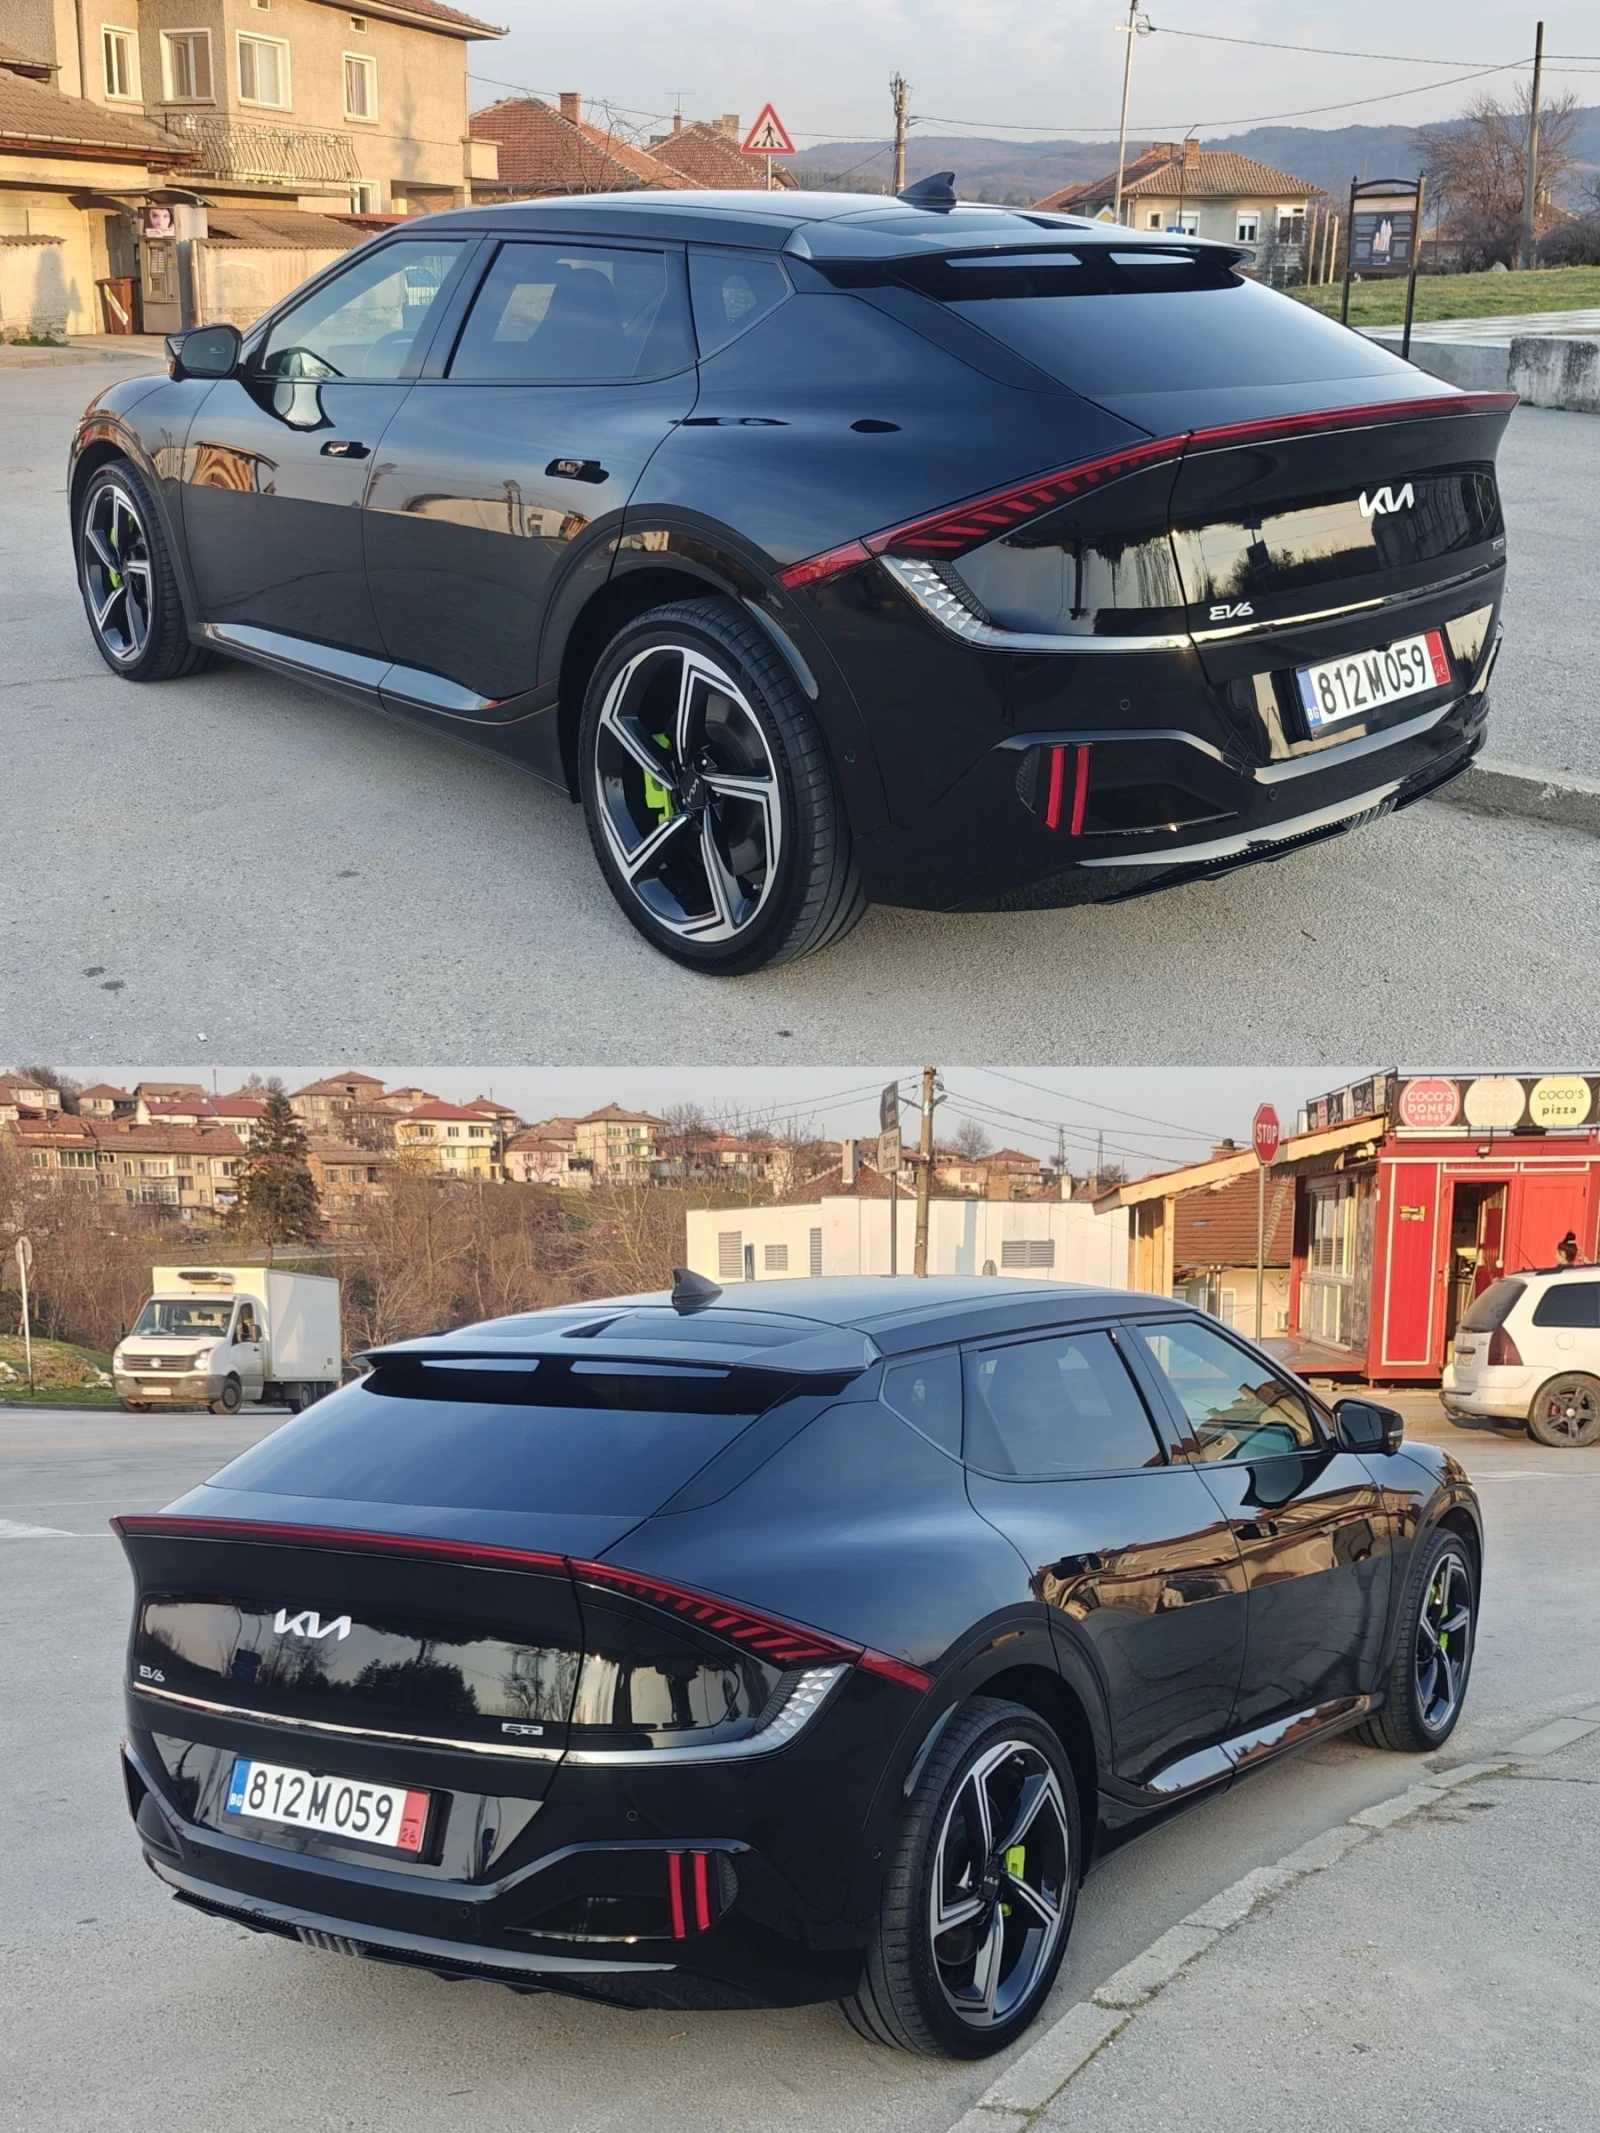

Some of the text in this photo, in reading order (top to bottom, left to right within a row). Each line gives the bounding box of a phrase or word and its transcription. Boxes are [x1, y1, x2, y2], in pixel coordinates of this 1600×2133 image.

[1358, 482, 1415, 518] KIA
[1208, 601, 1254, 621] EV6
[1317, 643, 1427, 715] 812M059
[1306, 706, 1320, 722] BG
[1407, 1091, 1453, 1102] COCO'S
[1538, 1089, 1585, 1101] COCO'S
[1408, 1103, 1454, 1114] DONER
[1542, 1104, 1577, 1116] pizza
[1414, 1113, 1447, 1122] kebab
[1256, 1123, 1278, 1145] STOP
[273, 1607, 352, 1642] KIA
[139, 1664, 166, 1683] EV6
[229, 1792, 244, 1809] BG
[248, 1770, 394, 1837] 812M059
[400, 1827, 417, 1844] 26
